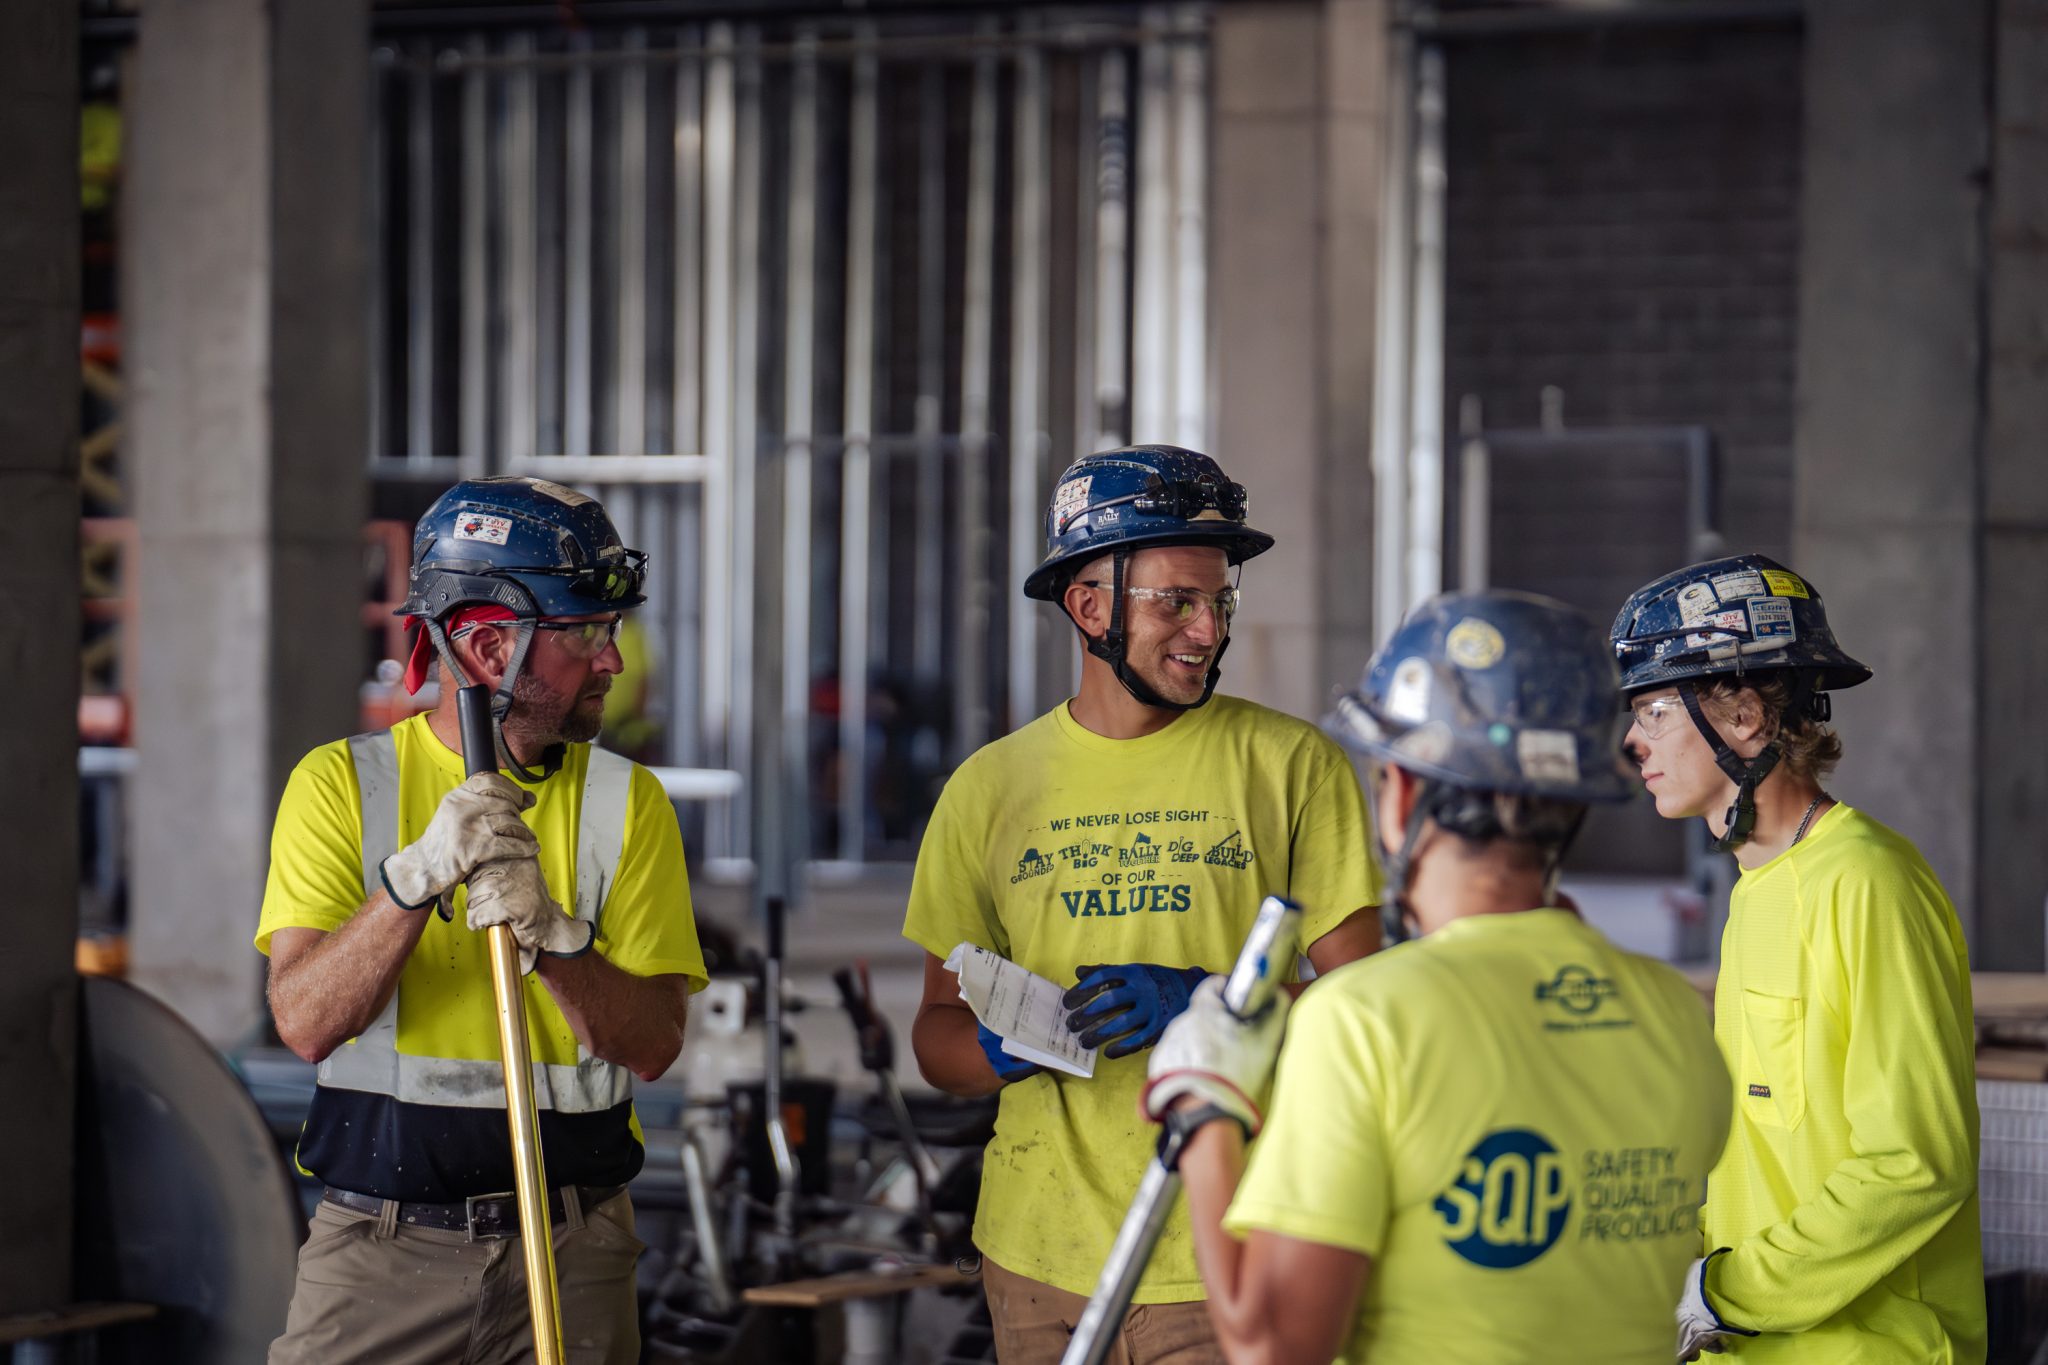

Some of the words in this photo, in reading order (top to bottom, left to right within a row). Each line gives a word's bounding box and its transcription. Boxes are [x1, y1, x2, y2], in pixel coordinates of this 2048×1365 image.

[1050, 818, 1071, 832] WE
[1076, 813, 1120, 829] NEVER
[1125, 811, 1160, 826] LOSE
[1165, 810, 1210, 823] SIGHT
[1073, 857, 1099, 870] BIG
[1118, 844, 1162, 862] RALLY
[1171, 853, 1200, 863] DEEP
[1204, 856, 1247, 870] LEGACIES
[1210, 843, 1254, 863] BUILD
[1010, 863, 1055, 885] GROUNDED
[1101, 873, 1122, 886] OF
[1127, 869, 1155, 884] OUR
[1060, 884, 1192, 918] VALUES
[1583, 1148, 1680, 1177] SAFETY
[1433, 1151, 1569, 1247] SQP
[1583, 1179, 1688, 1211] QUALITY
